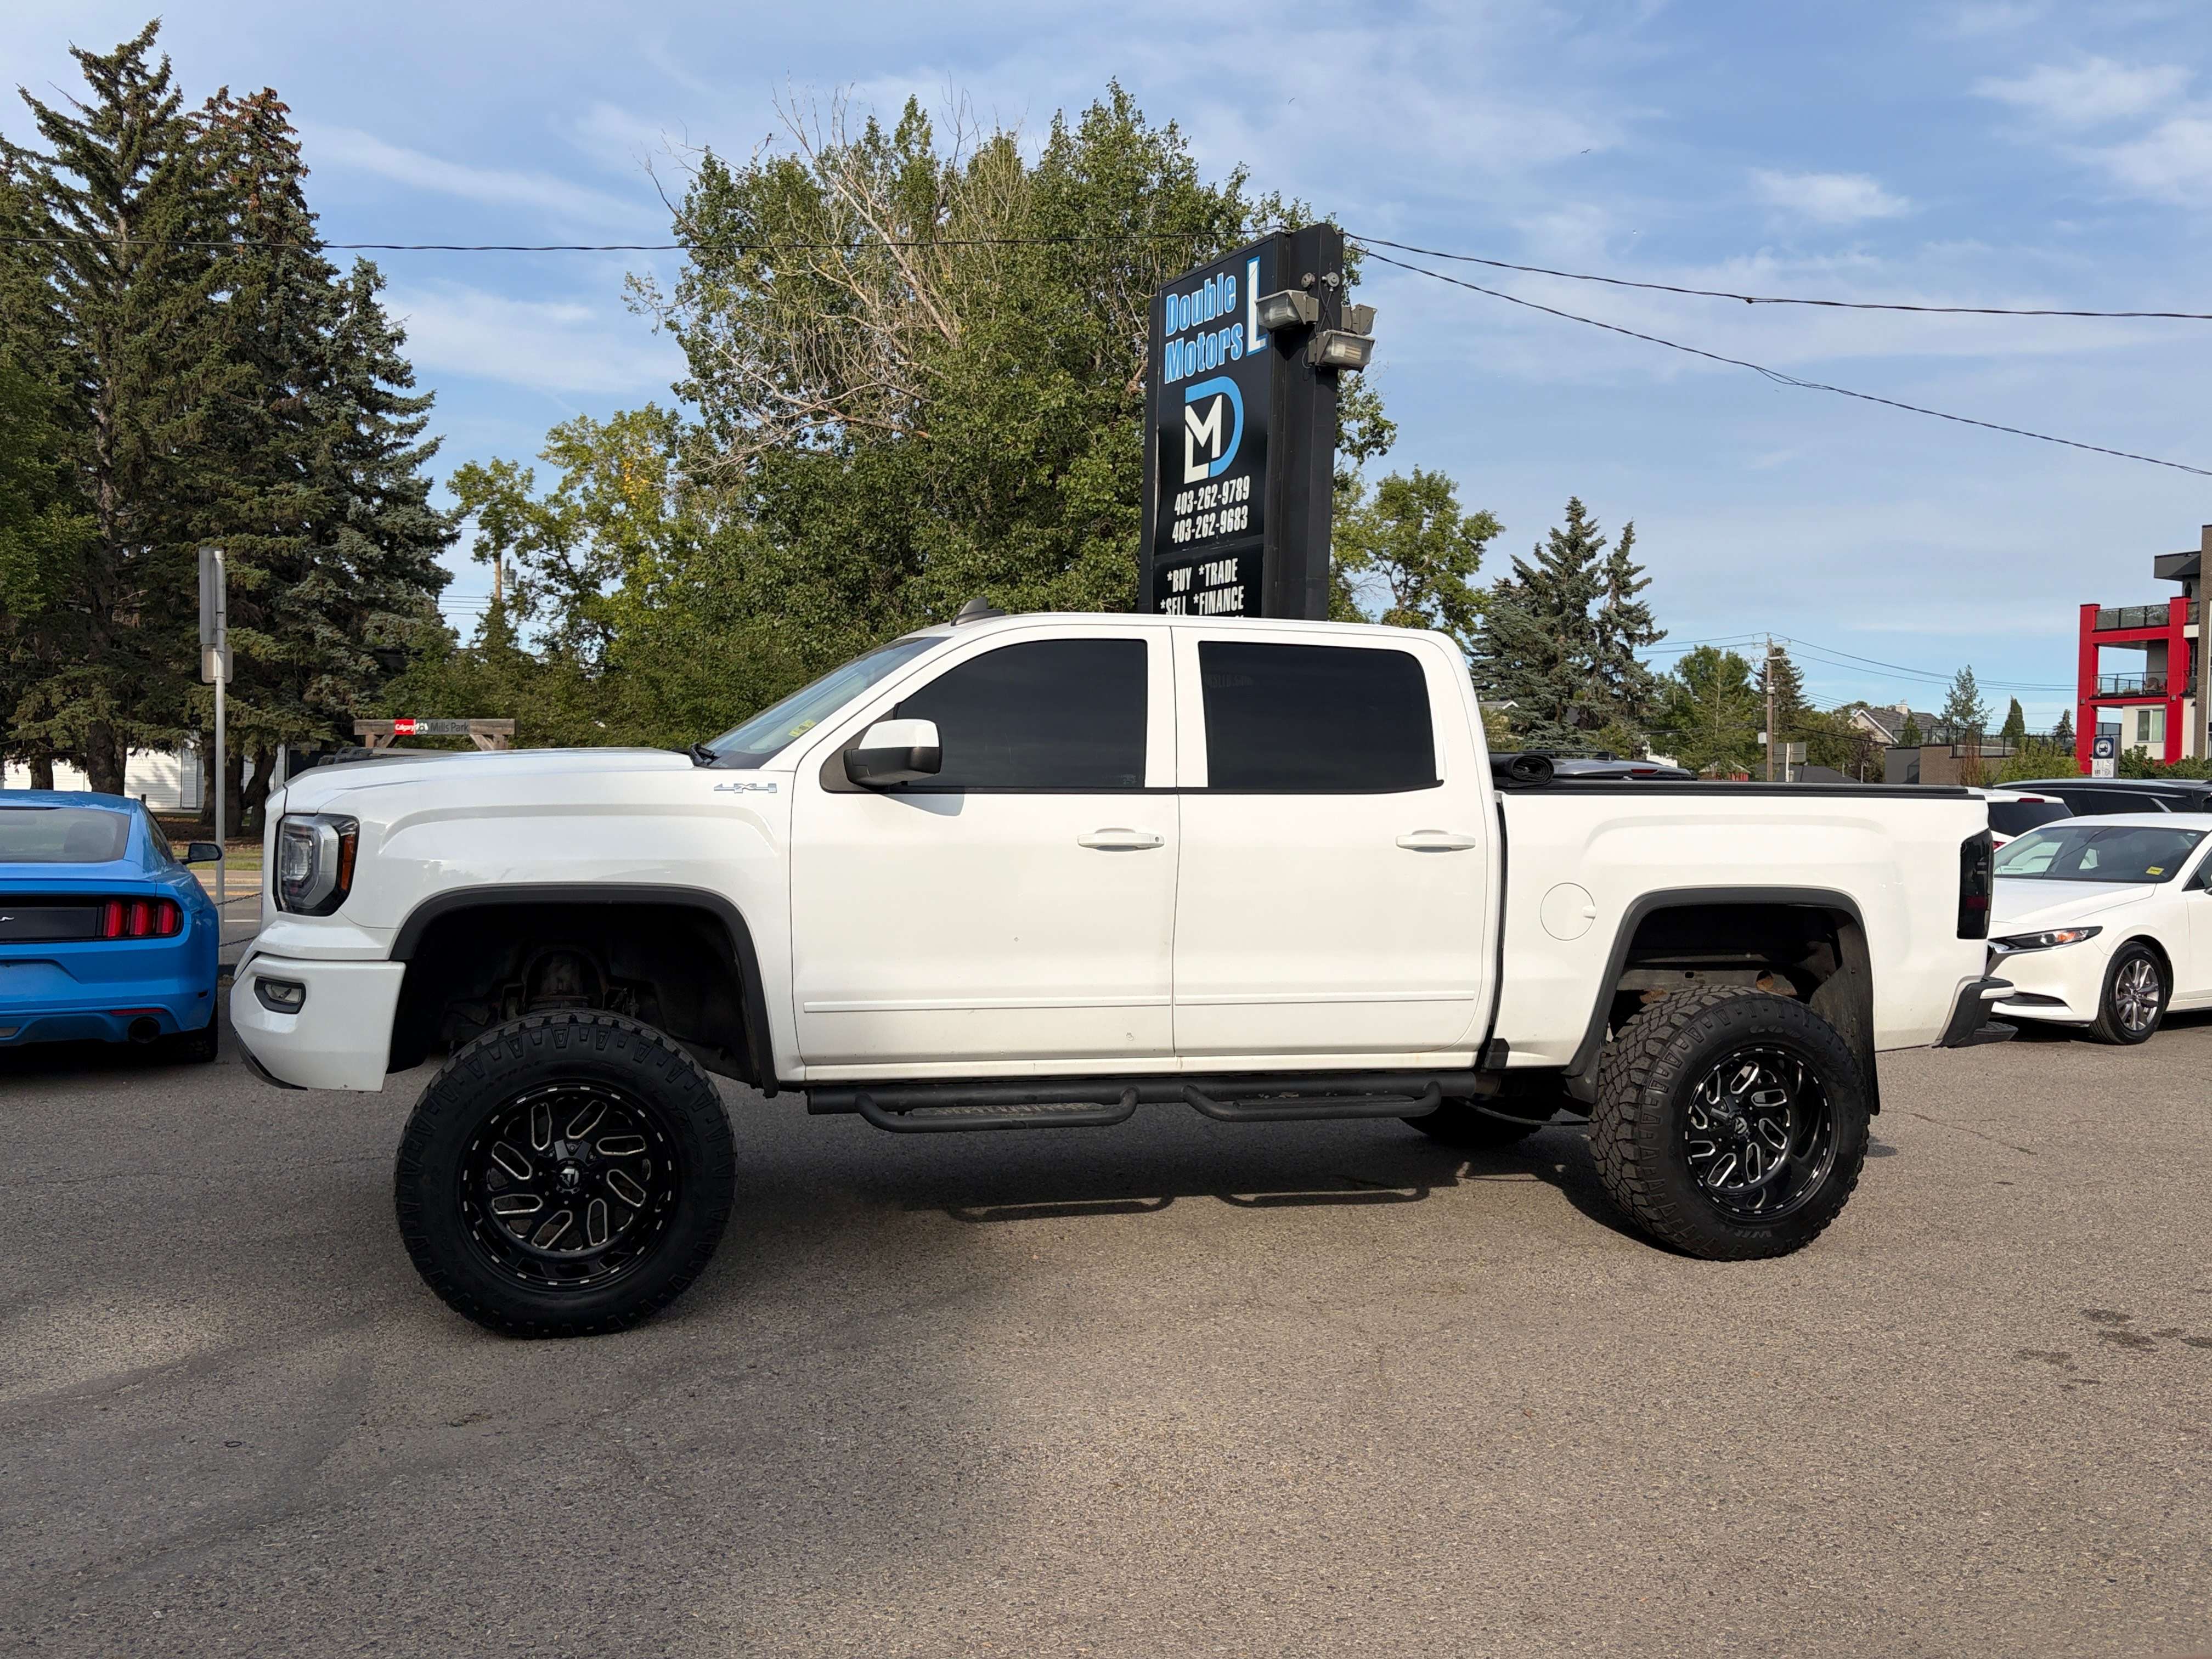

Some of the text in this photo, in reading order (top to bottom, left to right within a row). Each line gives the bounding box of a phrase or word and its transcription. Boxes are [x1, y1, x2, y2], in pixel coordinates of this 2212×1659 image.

[1165, 256, 1268, 356] Double L
[1164, 323, 1243, 384] Motors
[1174, 475, 1250, 516] 403-262-9789
[1172, 505, 1248, 543] 403-262-9683
[395, 724, 415, 732] Calgary
[431, 723, 449, 732] Mills
[451, 722, 469, 732] Park
